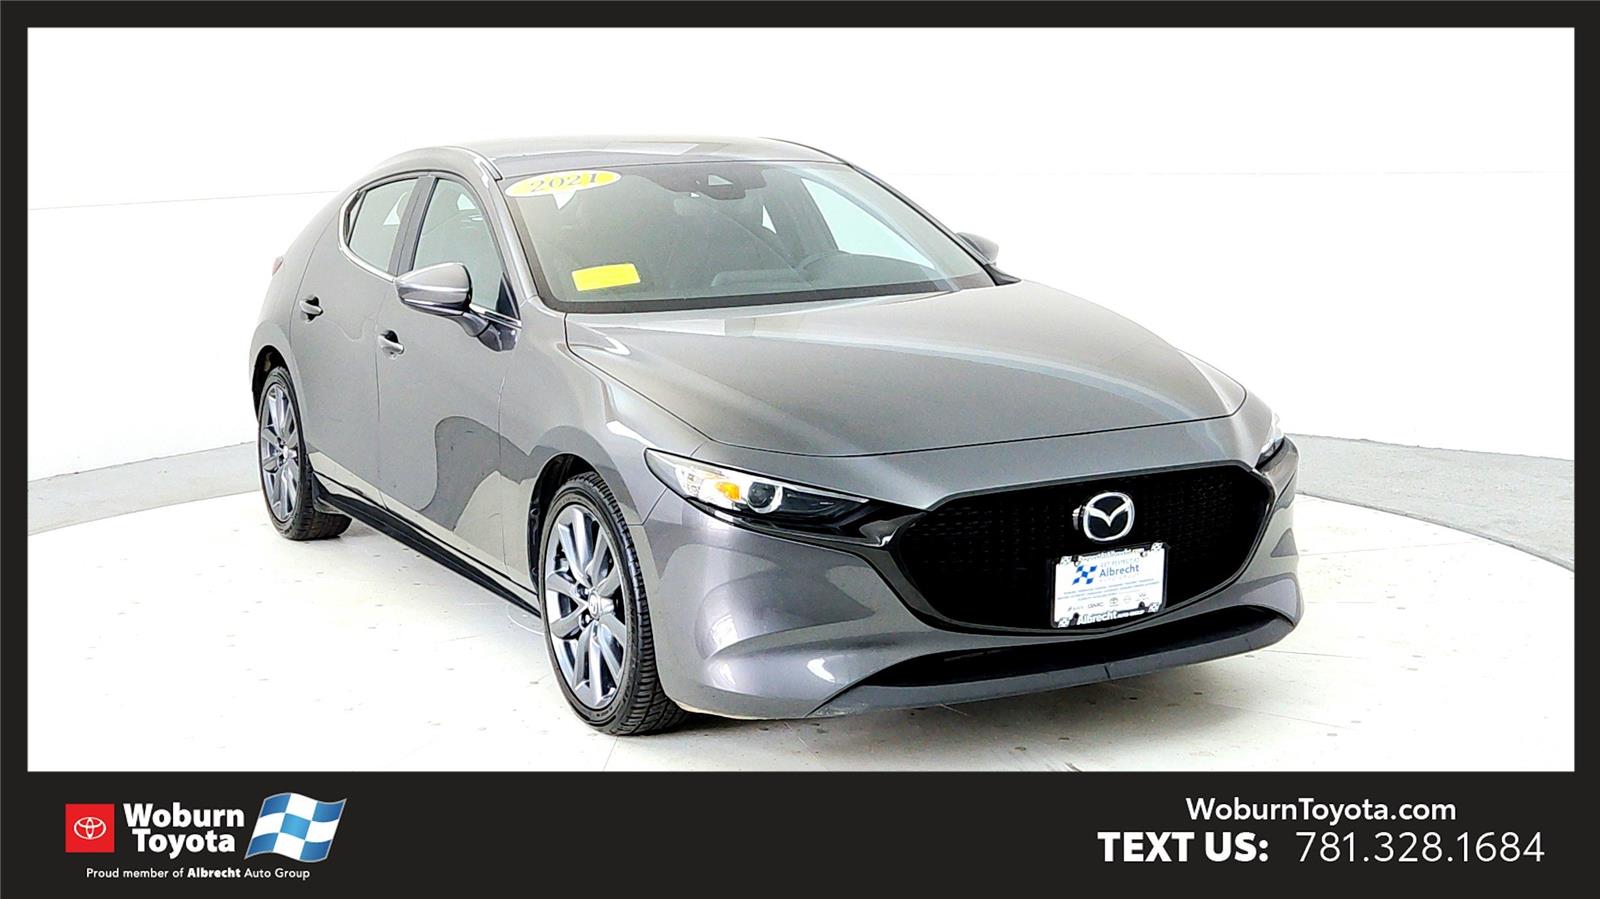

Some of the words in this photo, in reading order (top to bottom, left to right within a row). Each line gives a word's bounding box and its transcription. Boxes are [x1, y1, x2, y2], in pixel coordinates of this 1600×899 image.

[530, 173, 599, 193] 2021
[1099, 564, 1140, 578] Albrecht
[1077, 611, 1118, 625] Albrecht
